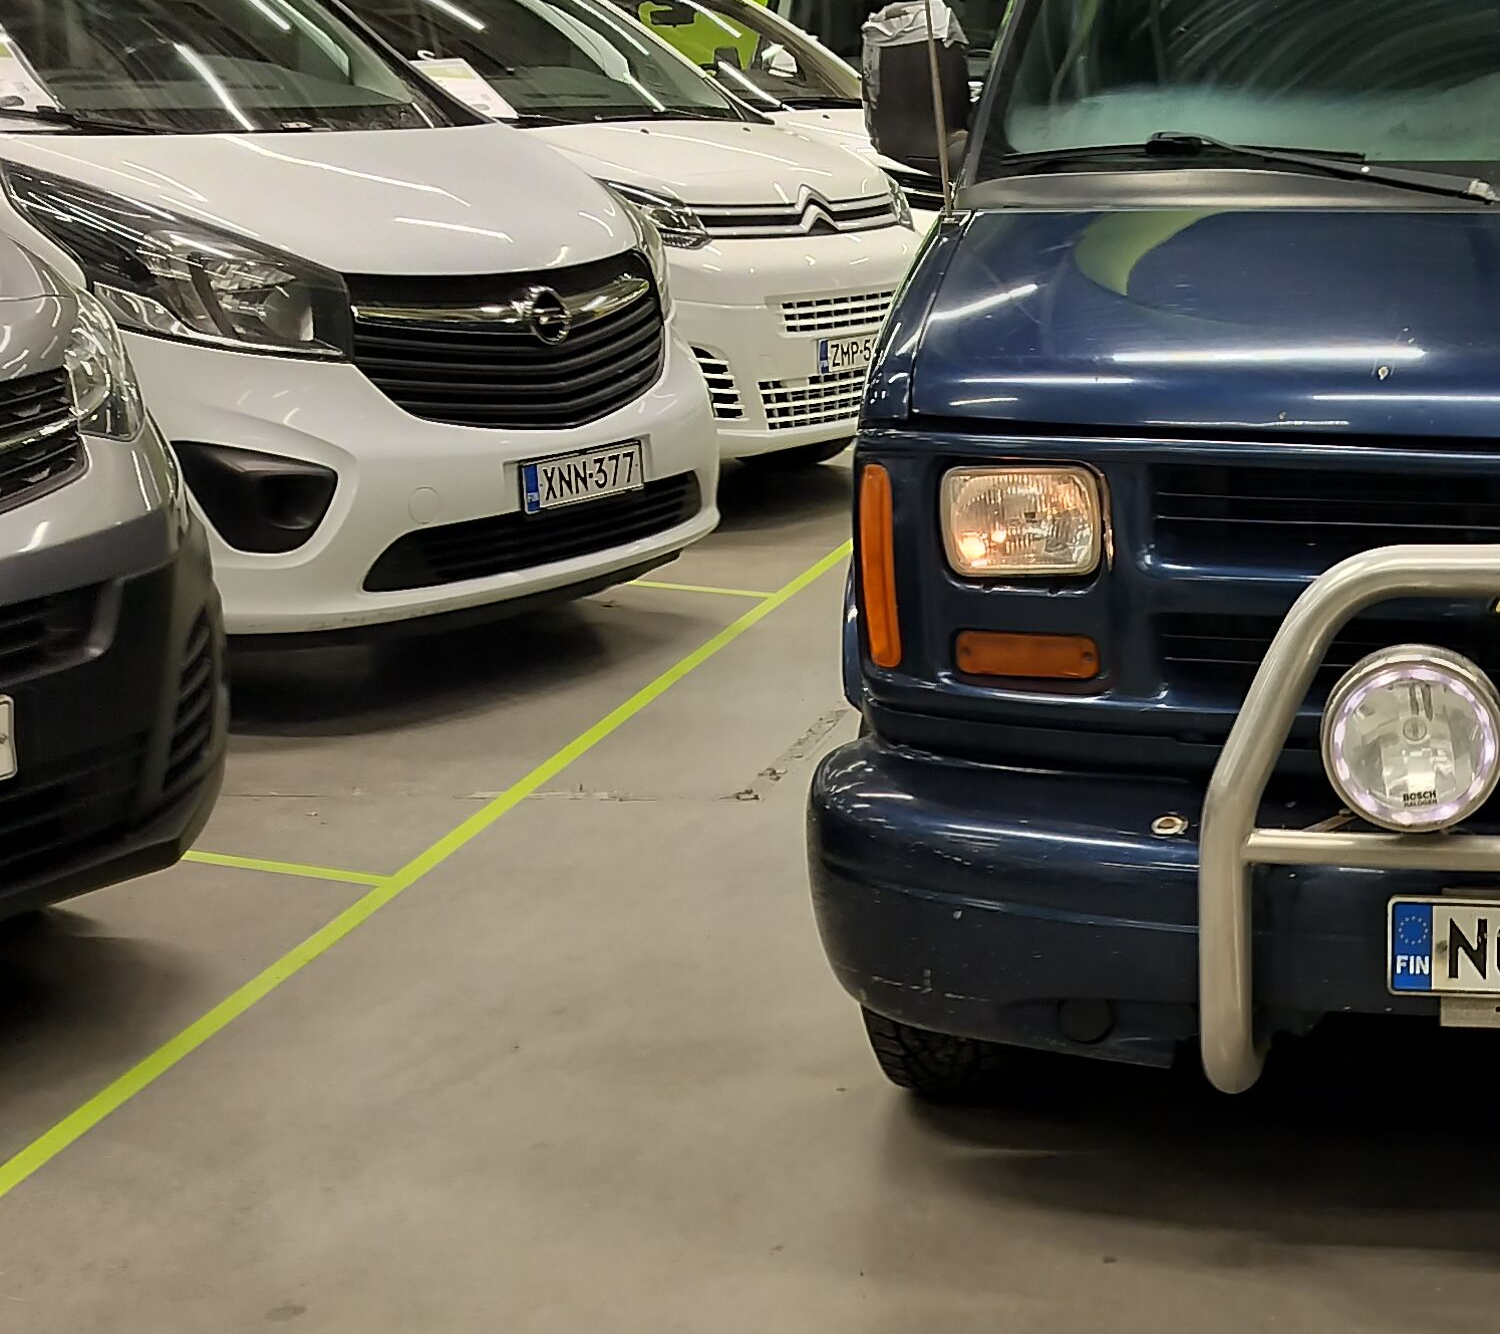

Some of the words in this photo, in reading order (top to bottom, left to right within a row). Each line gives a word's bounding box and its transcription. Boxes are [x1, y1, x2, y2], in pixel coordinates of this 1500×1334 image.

[542, 450, 635, 501] XNN-377
[1402, 789, 1437, 802] BOSCH
[1396, 955, 1430, 975] FIN
